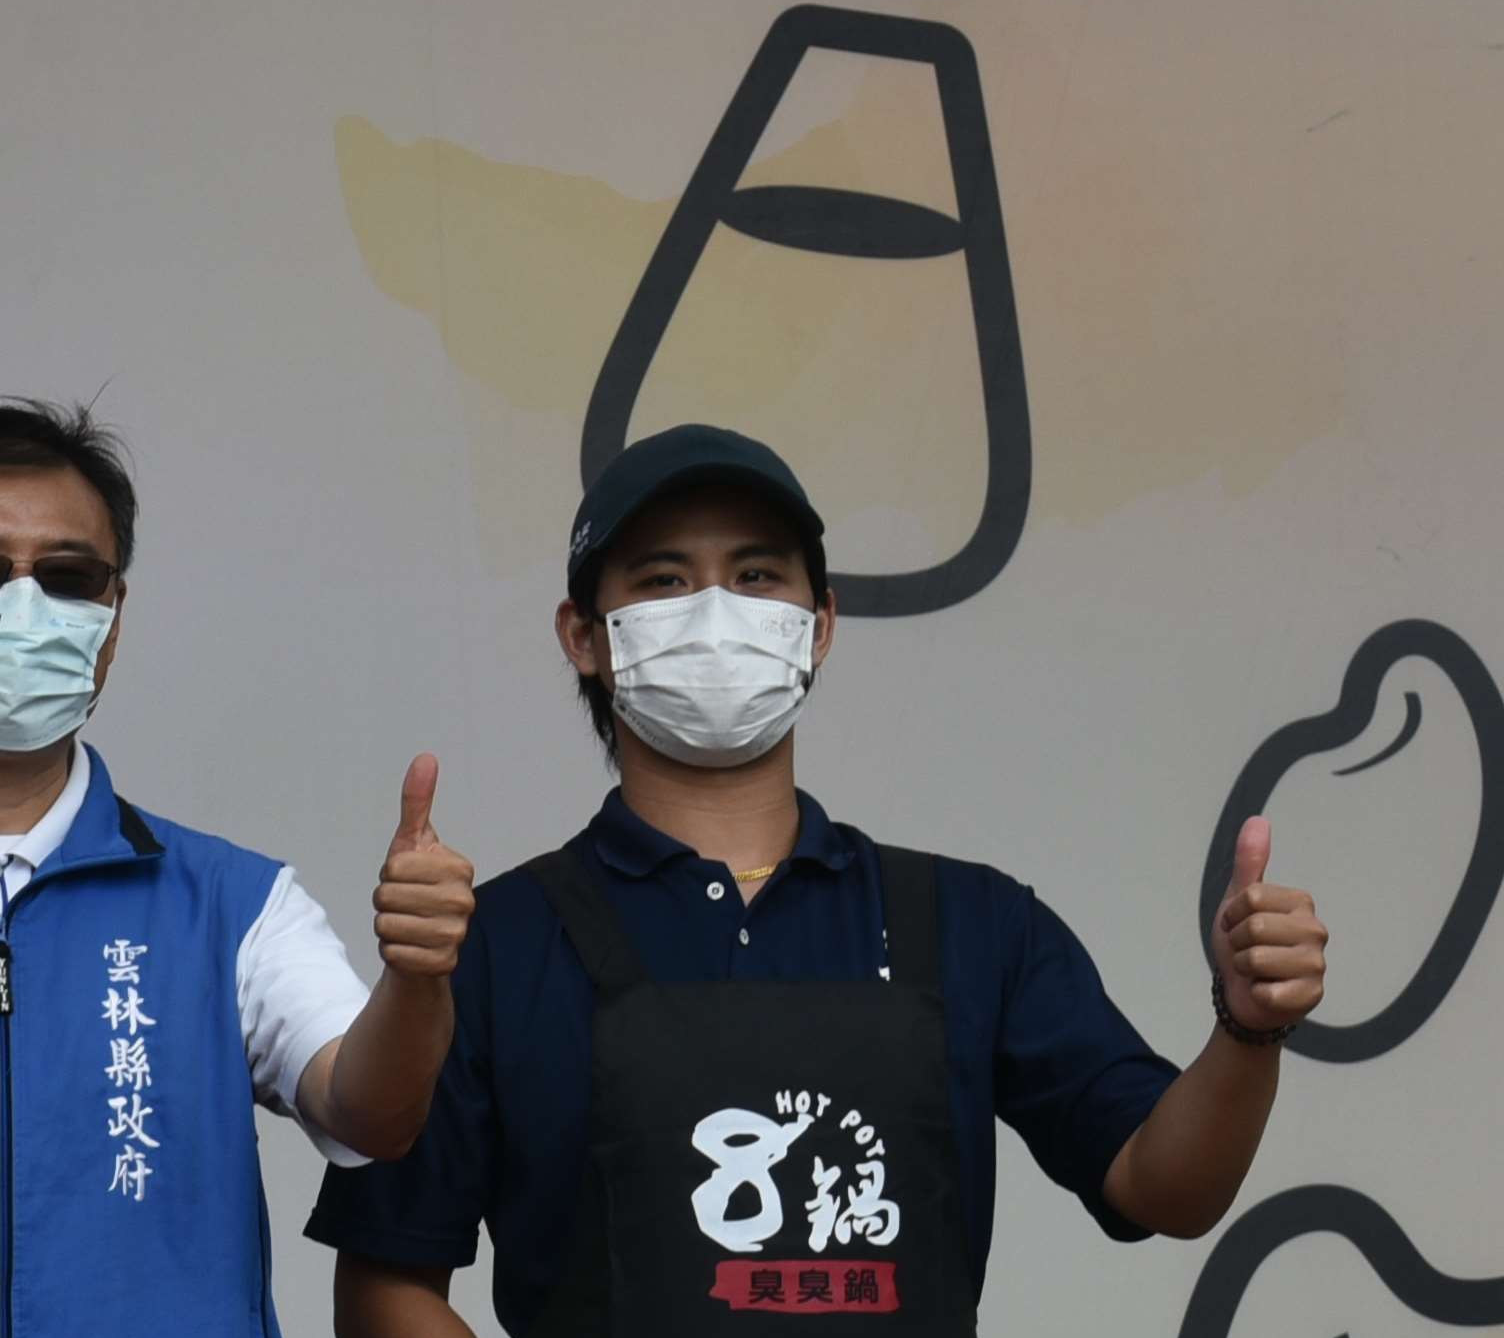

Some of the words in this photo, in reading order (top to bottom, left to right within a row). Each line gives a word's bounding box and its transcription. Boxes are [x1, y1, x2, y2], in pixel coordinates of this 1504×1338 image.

[100, 937, 161, 1204] 雲林縣政府
[775, 1089, 832, 1118] HOT
[840, 1109, 886, 1158] POT
[749, 1268, 880, 1304] 臭臭鍋
